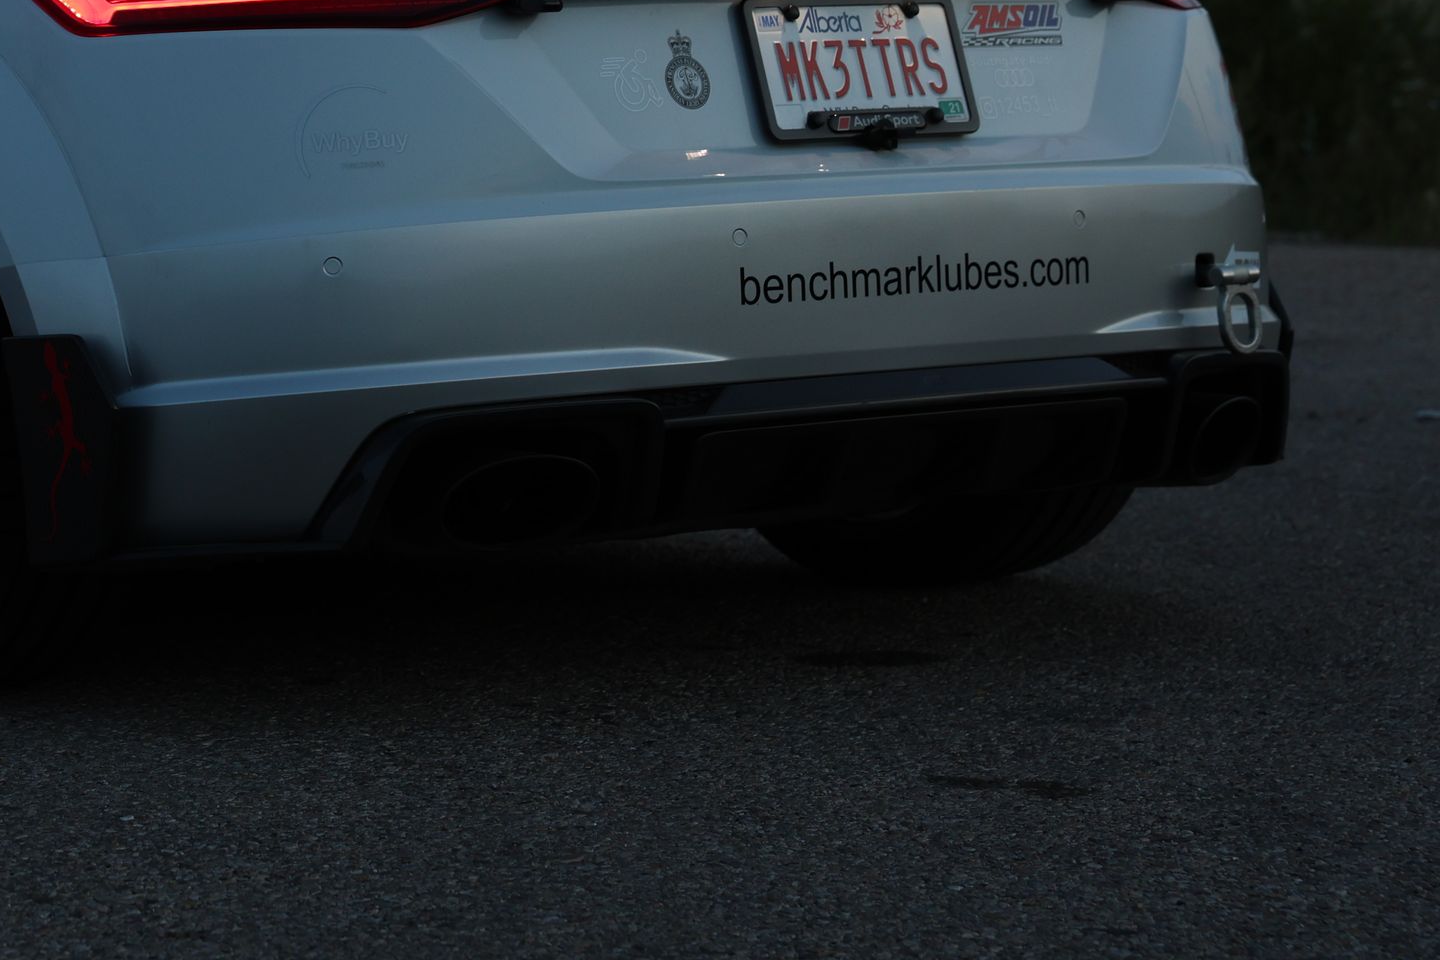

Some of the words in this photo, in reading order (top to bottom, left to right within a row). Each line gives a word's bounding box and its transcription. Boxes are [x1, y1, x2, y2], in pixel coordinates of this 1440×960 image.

[761, 14, 781, 28] MAY
[799, 7, 863, 34] Alberta
[967, 4, 1059, 35] AMSOIL
[996, 37, 1062, 48] RACING
[774, 37, 949, 102] MK3TTRS
[949, 102, 962, 115] 21
[311, 129, 409, 157] WhyBuy
[739, 252, 1091, 305] benchmarklubes.com
